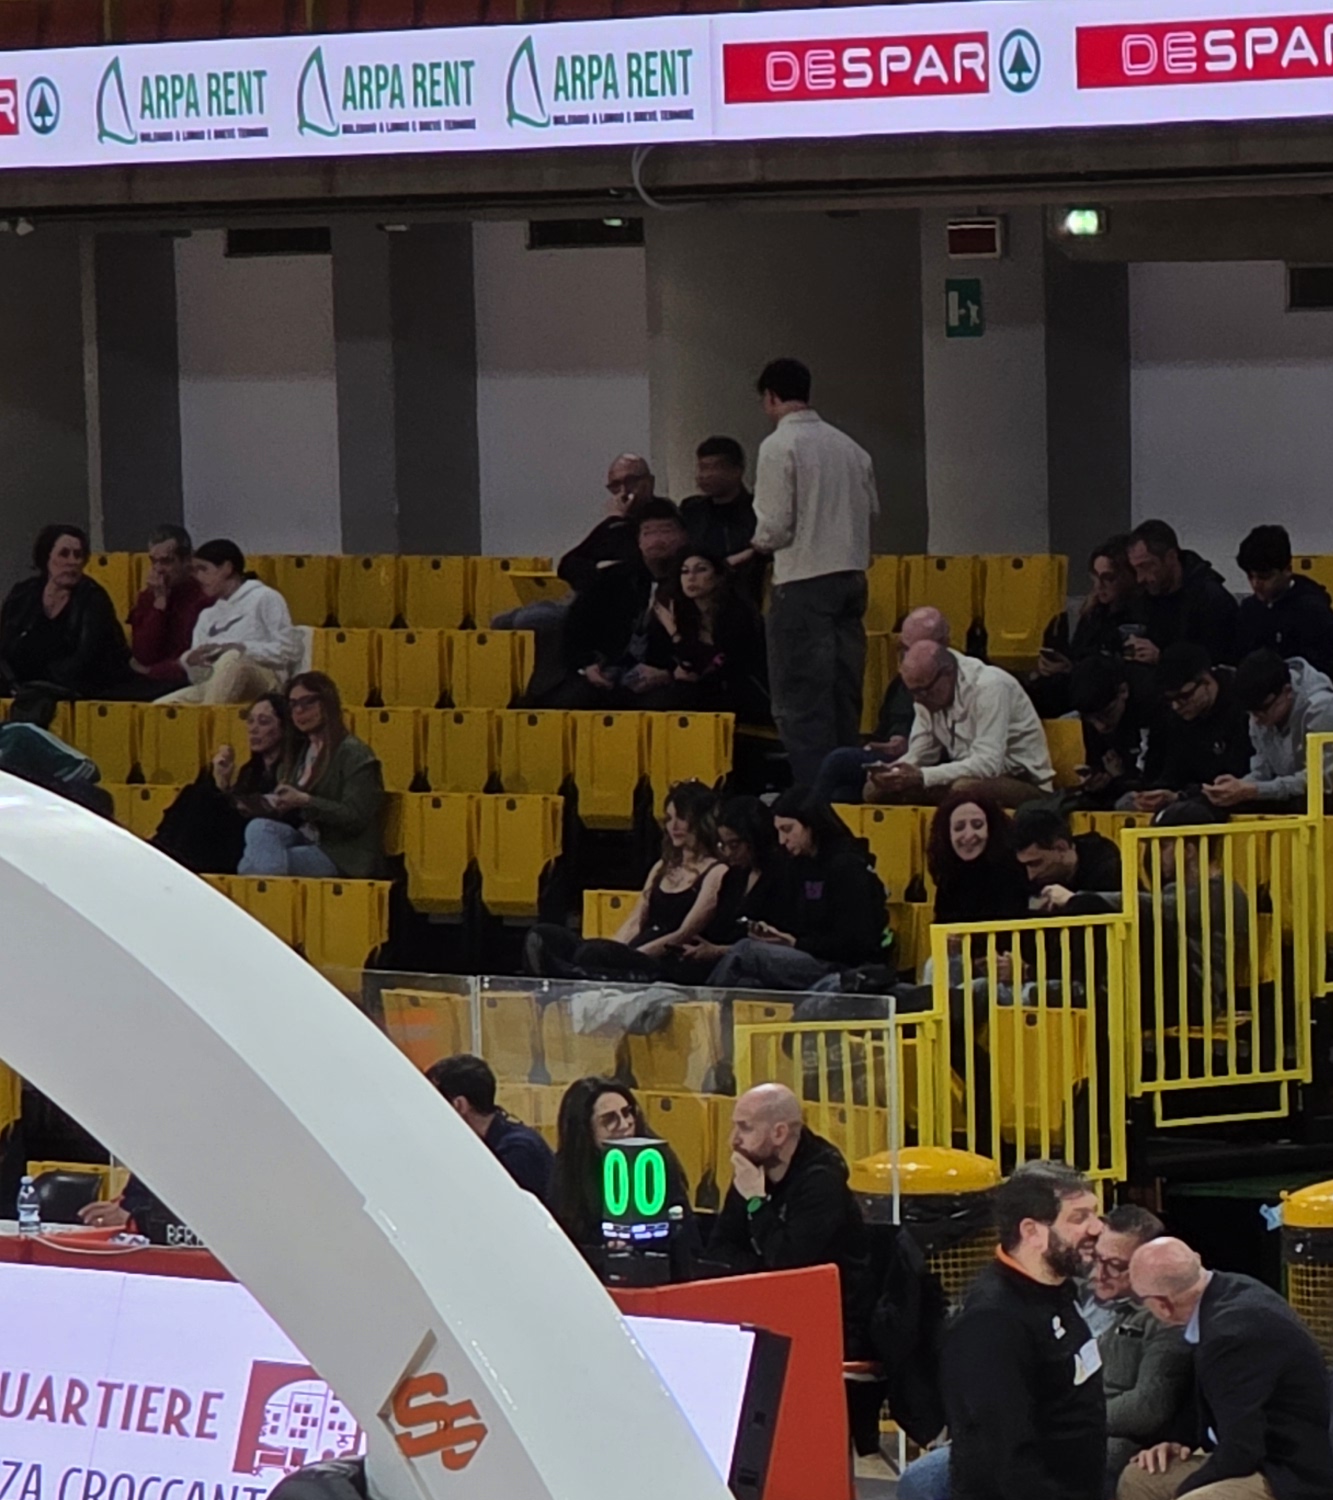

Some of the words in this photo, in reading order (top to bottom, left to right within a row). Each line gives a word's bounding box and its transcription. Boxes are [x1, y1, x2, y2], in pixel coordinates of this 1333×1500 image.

[342, 63, 405, 111] ARPA
[412, 60, 475, 108] RENT
[554, 53, 619, 102] ARPA
[627, 49, 693, 98] RENT
[765, 42, 986, 92] DESPAR
[140, 73, 199, 119] ARPA
[207, 70, 267, 117] RENT
[604, 1148, 666, 1216] 00
[0, 1372, 224, 1440] UARTIERE
